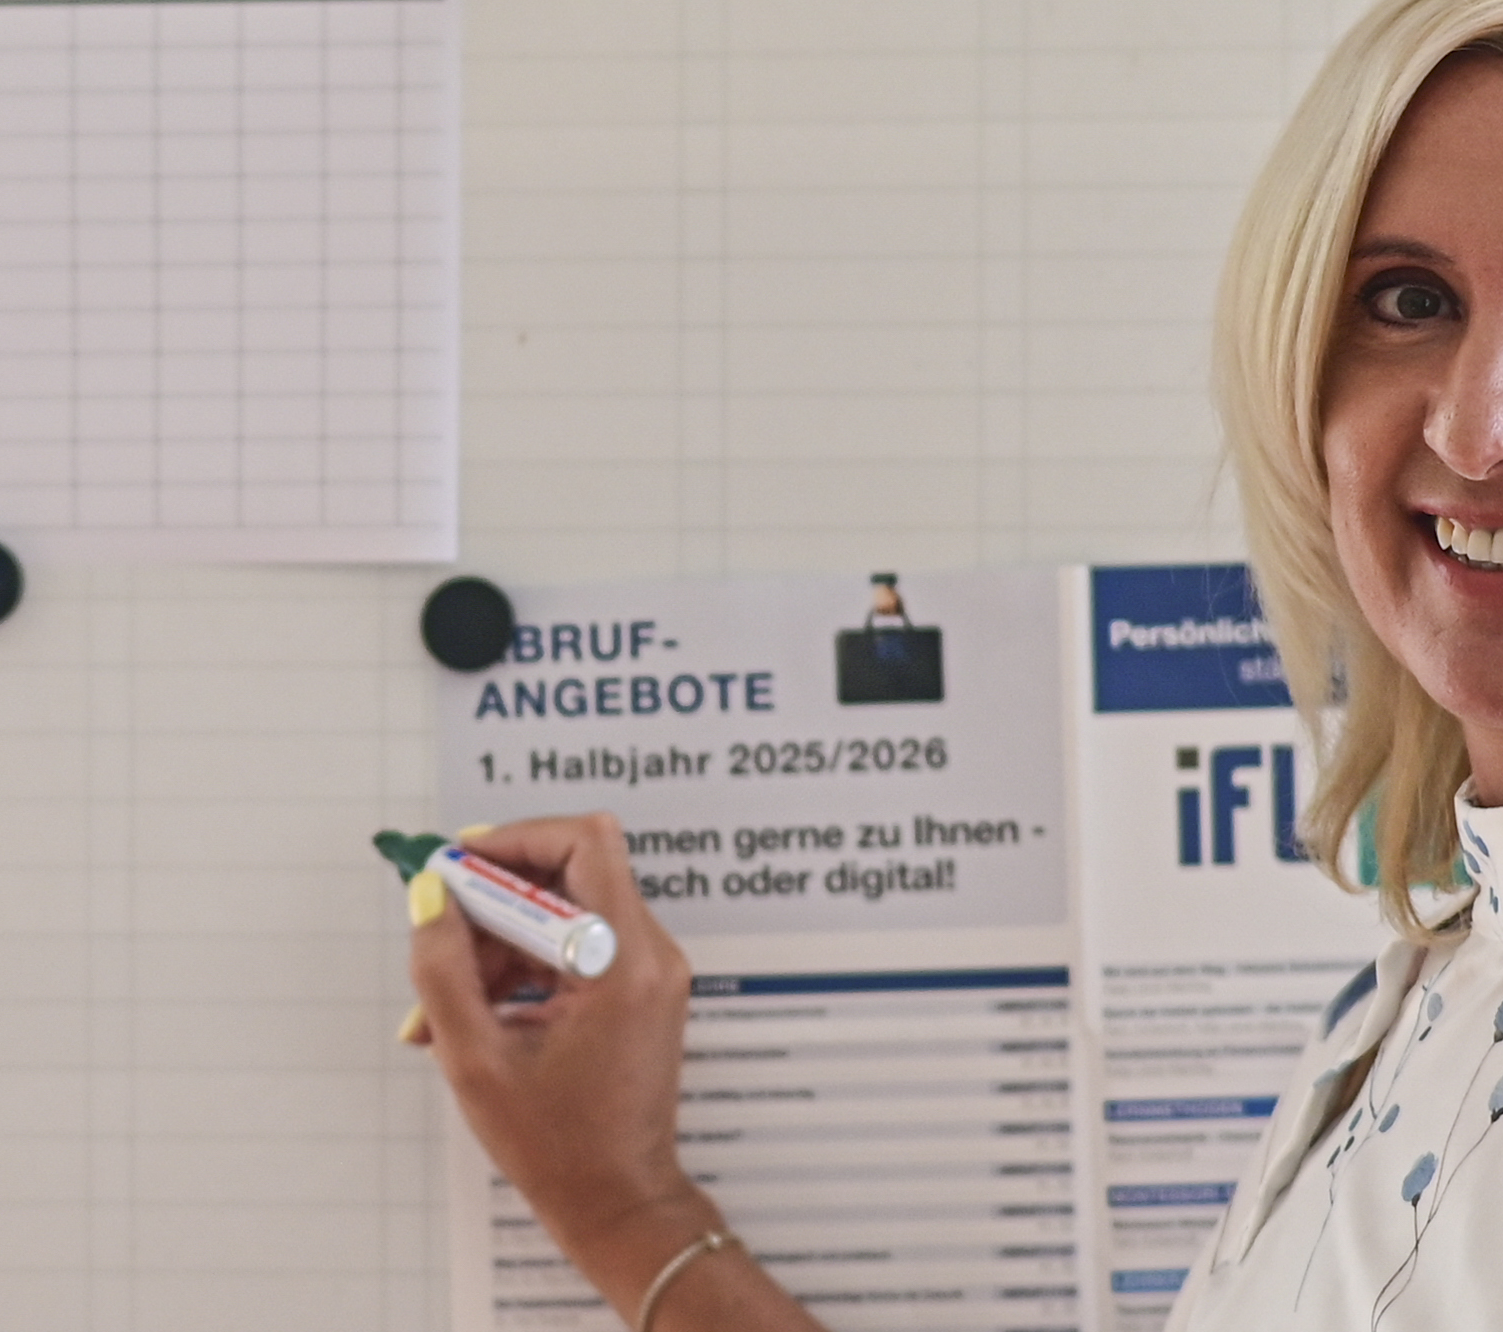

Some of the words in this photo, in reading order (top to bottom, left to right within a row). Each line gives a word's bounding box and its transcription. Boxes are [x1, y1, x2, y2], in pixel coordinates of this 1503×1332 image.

[512, 620, 679, 663] BRUF-
[1109, 617, 1274, 651] Persönlich
[475, 672, 775, 720] ANGEBOTE
[478, 753, 512, 784] 1.
[529, 747, 711, 786] Halbjahr
[728, 736, 949, 777] 2025/2026
[734, 824, 845, 860] gerne
[857, 820, 899, 848] zu
[914, 814, 1019, 847] Ihnen
[632, 865, 710, 900] sch
[721, 862, 809, 899] oder
[824, 859, 956, 902] digital!
